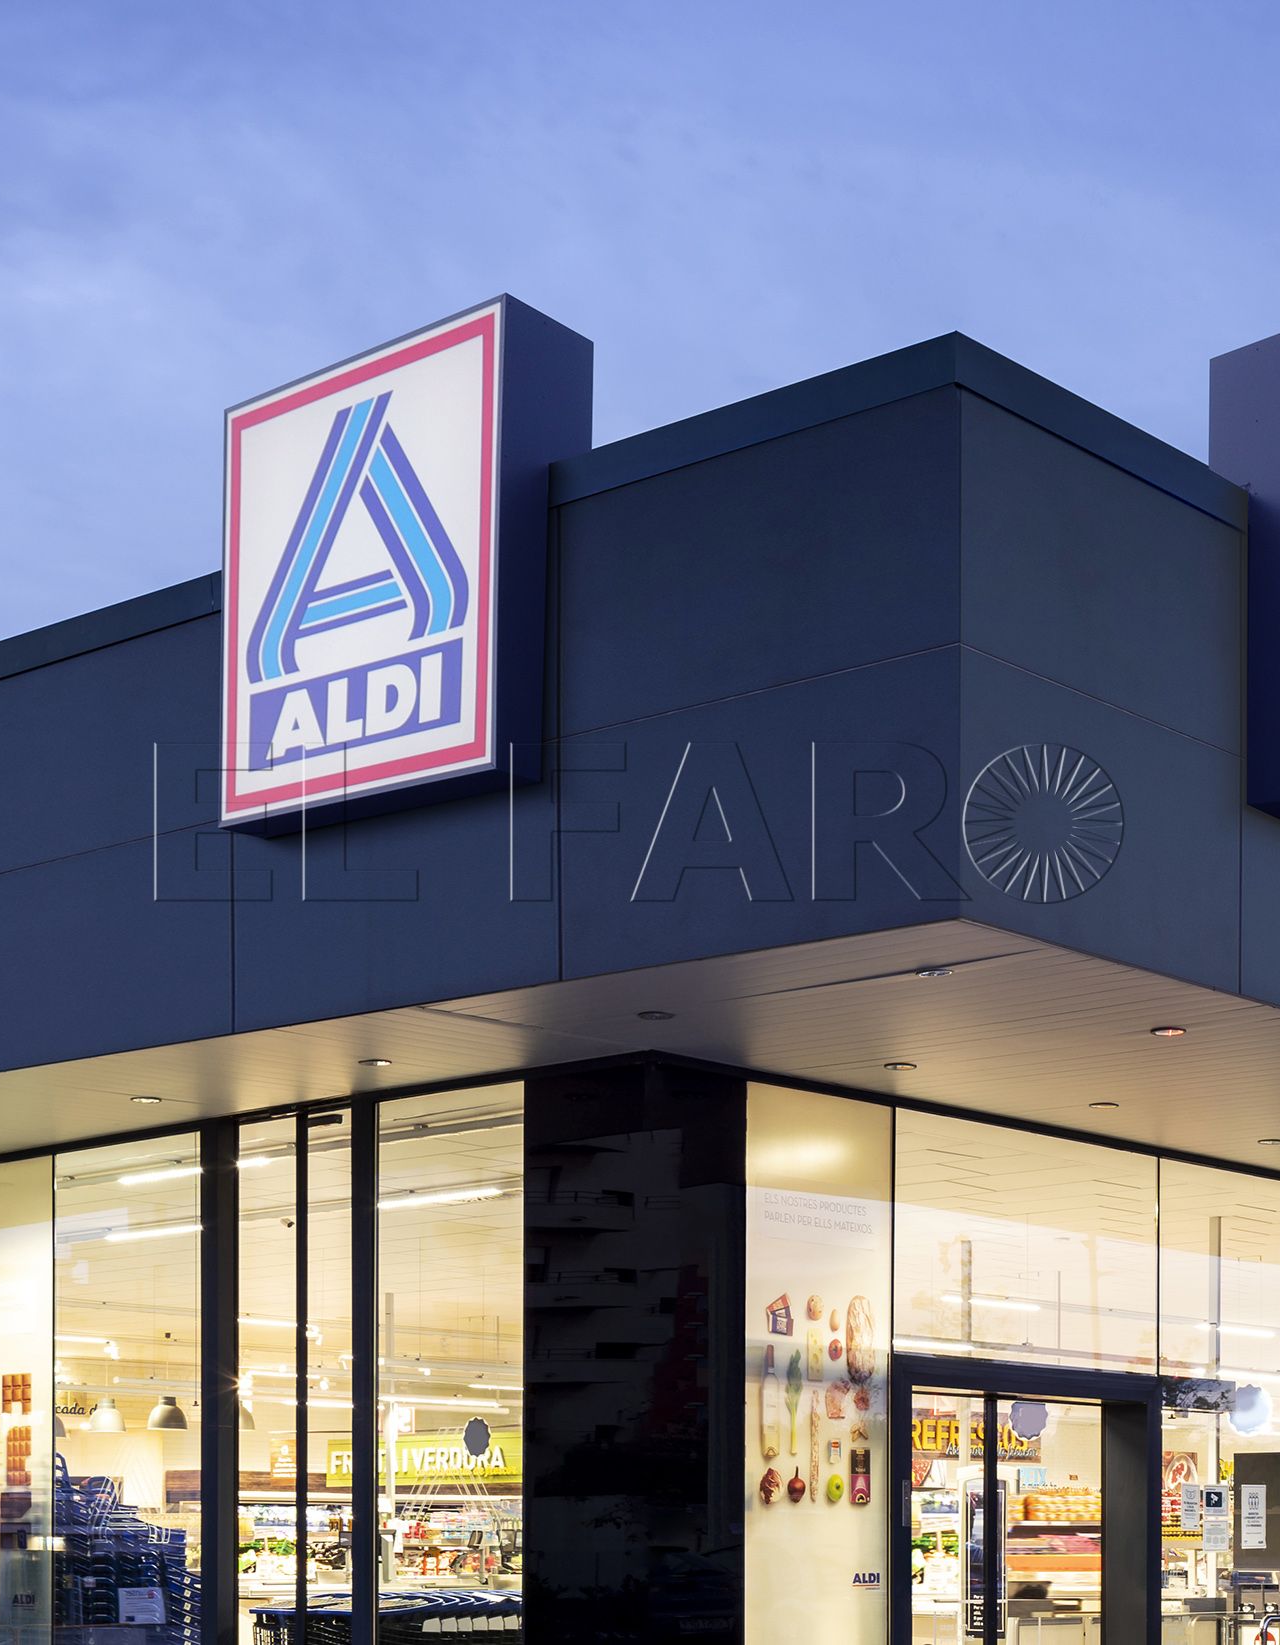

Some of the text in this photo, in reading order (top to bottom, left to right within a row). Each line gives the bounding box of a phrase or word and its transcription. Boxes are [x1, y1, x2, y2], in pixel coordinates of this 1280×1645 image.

[266, 652, 443, 760] ALDI
[764, 1192, 867, 1217] ELS NOSTRES PRODUCTES
[764, 1210, 796, 1224] PARLEN
[797, 1214, 813, 1226] PER
[814, 1217, 833, 1230] ELLS
[852, 1572, 881, 1584] ALDI
[11, 1593, 36, 1605] ALDI
